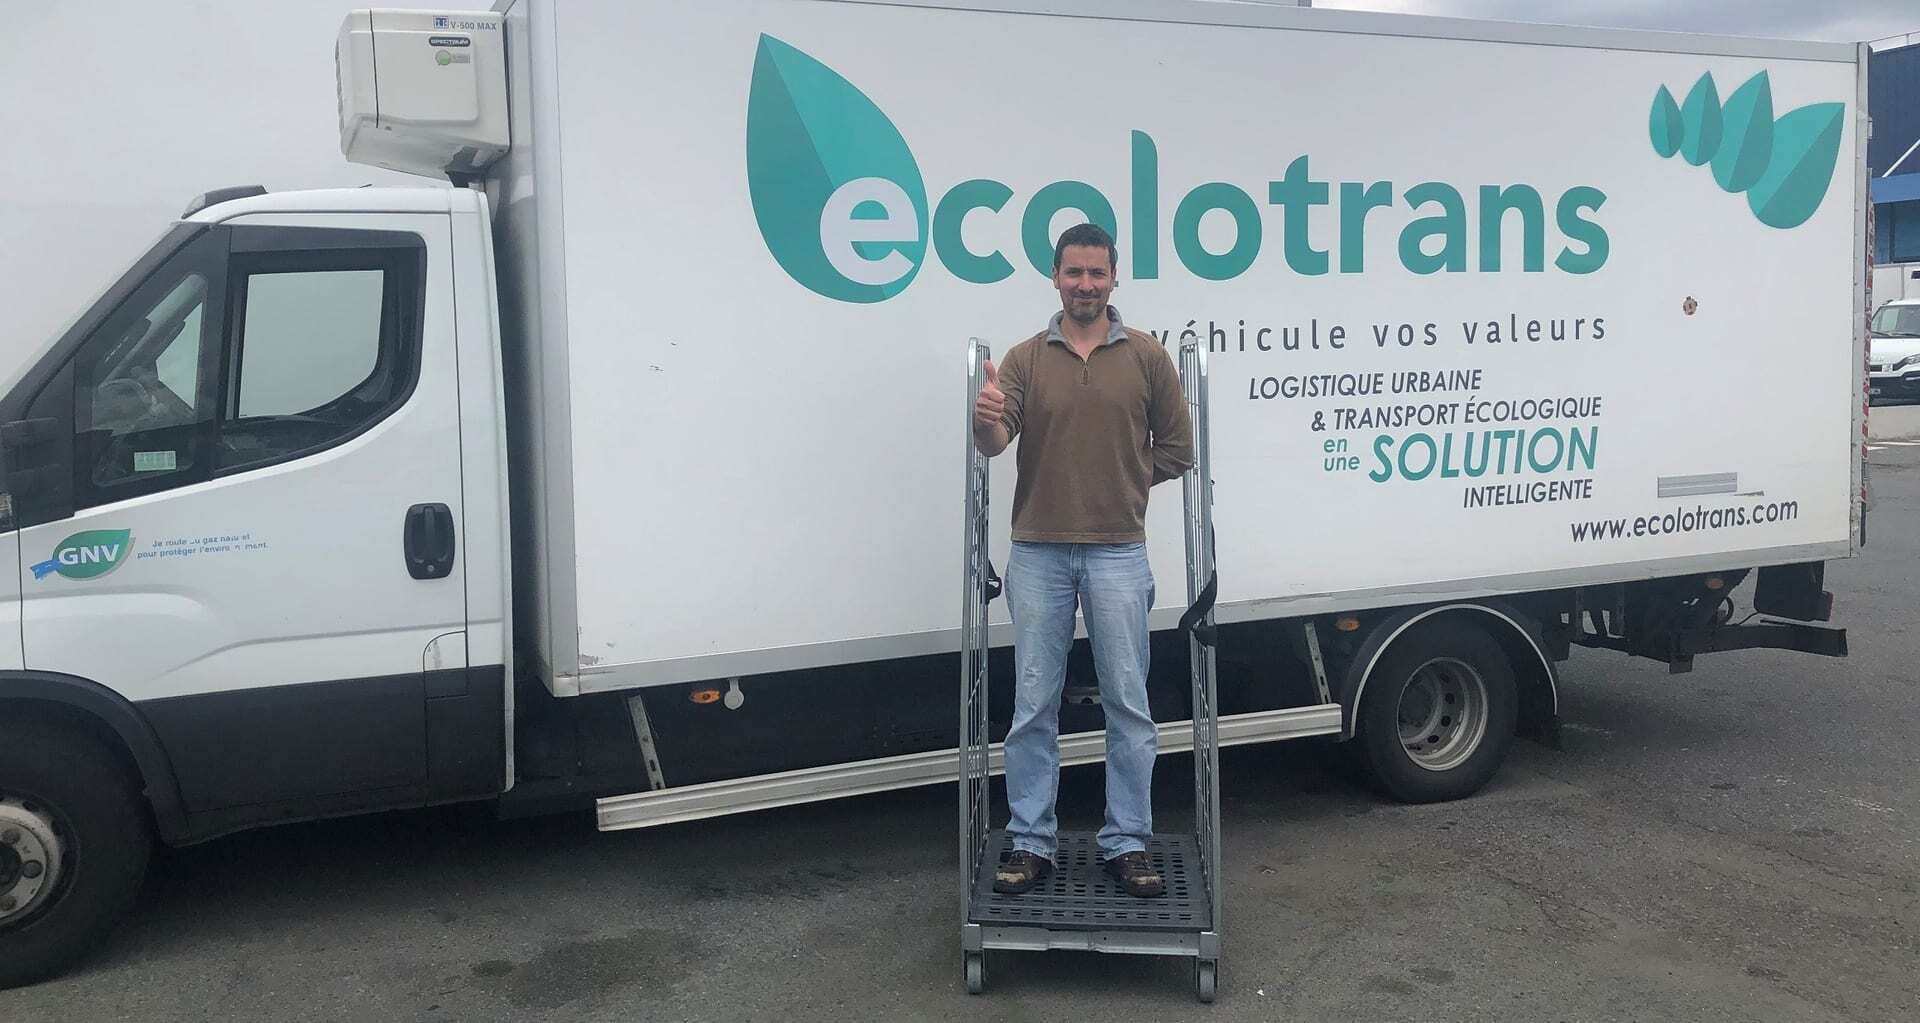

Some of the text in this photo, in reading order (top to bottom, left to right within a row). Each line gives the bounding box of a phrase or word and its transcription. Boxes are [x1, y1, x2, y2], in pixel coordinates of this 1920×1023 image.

[450, 21, 474, 29] V-500
[477, 22, 497, 30] MAX
[820, 130, 1609, 287] ecolotrans
[1373, 322, 1438, 347] vos
[1463, 314, 1605, 344] valeurs
[1249, 369, 1482, 400] LOGISTIQUE URBAINE
[1311, 395, 1602, 431] & TRANSPORT ÉCOLOGIQUE
[1323, 438, 1348, 453] en
[1368, 426, 1599, 483] SOLUTION
[1323, 454, 1361, 471] une
[1463, 479, 1593, 508] INTELLIGENTE
[1571, 500, 1798, 543] www.ecolotrans.com
[58, 543, 120, 565] GNV
